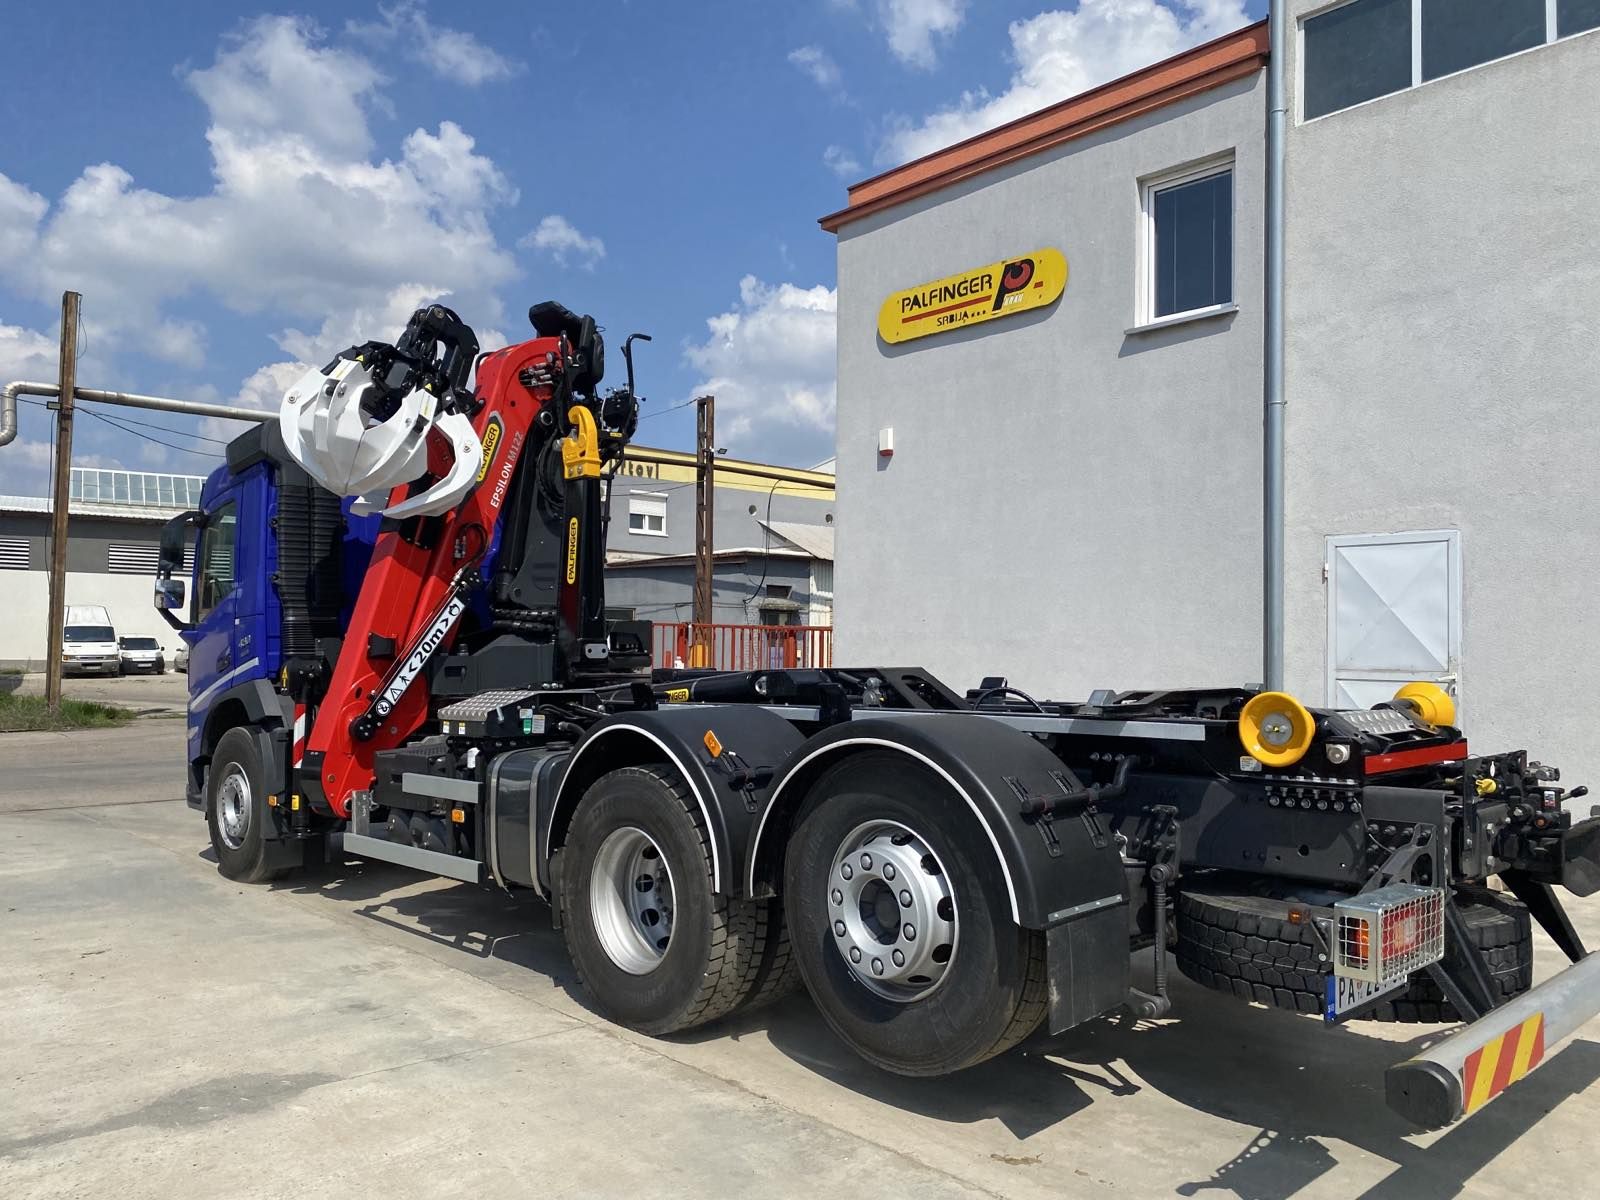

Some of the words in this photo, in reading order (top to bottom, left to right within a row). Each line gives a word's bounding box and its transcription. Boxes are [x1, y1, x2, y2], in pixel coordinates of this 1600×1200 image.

[901, 273, 993, 314] PALFINGER
[478, 426, 498, 479] FINGER
[490, 462, 513, 508] EPSILON
[568, 520, 577, 580] PALFINGER
